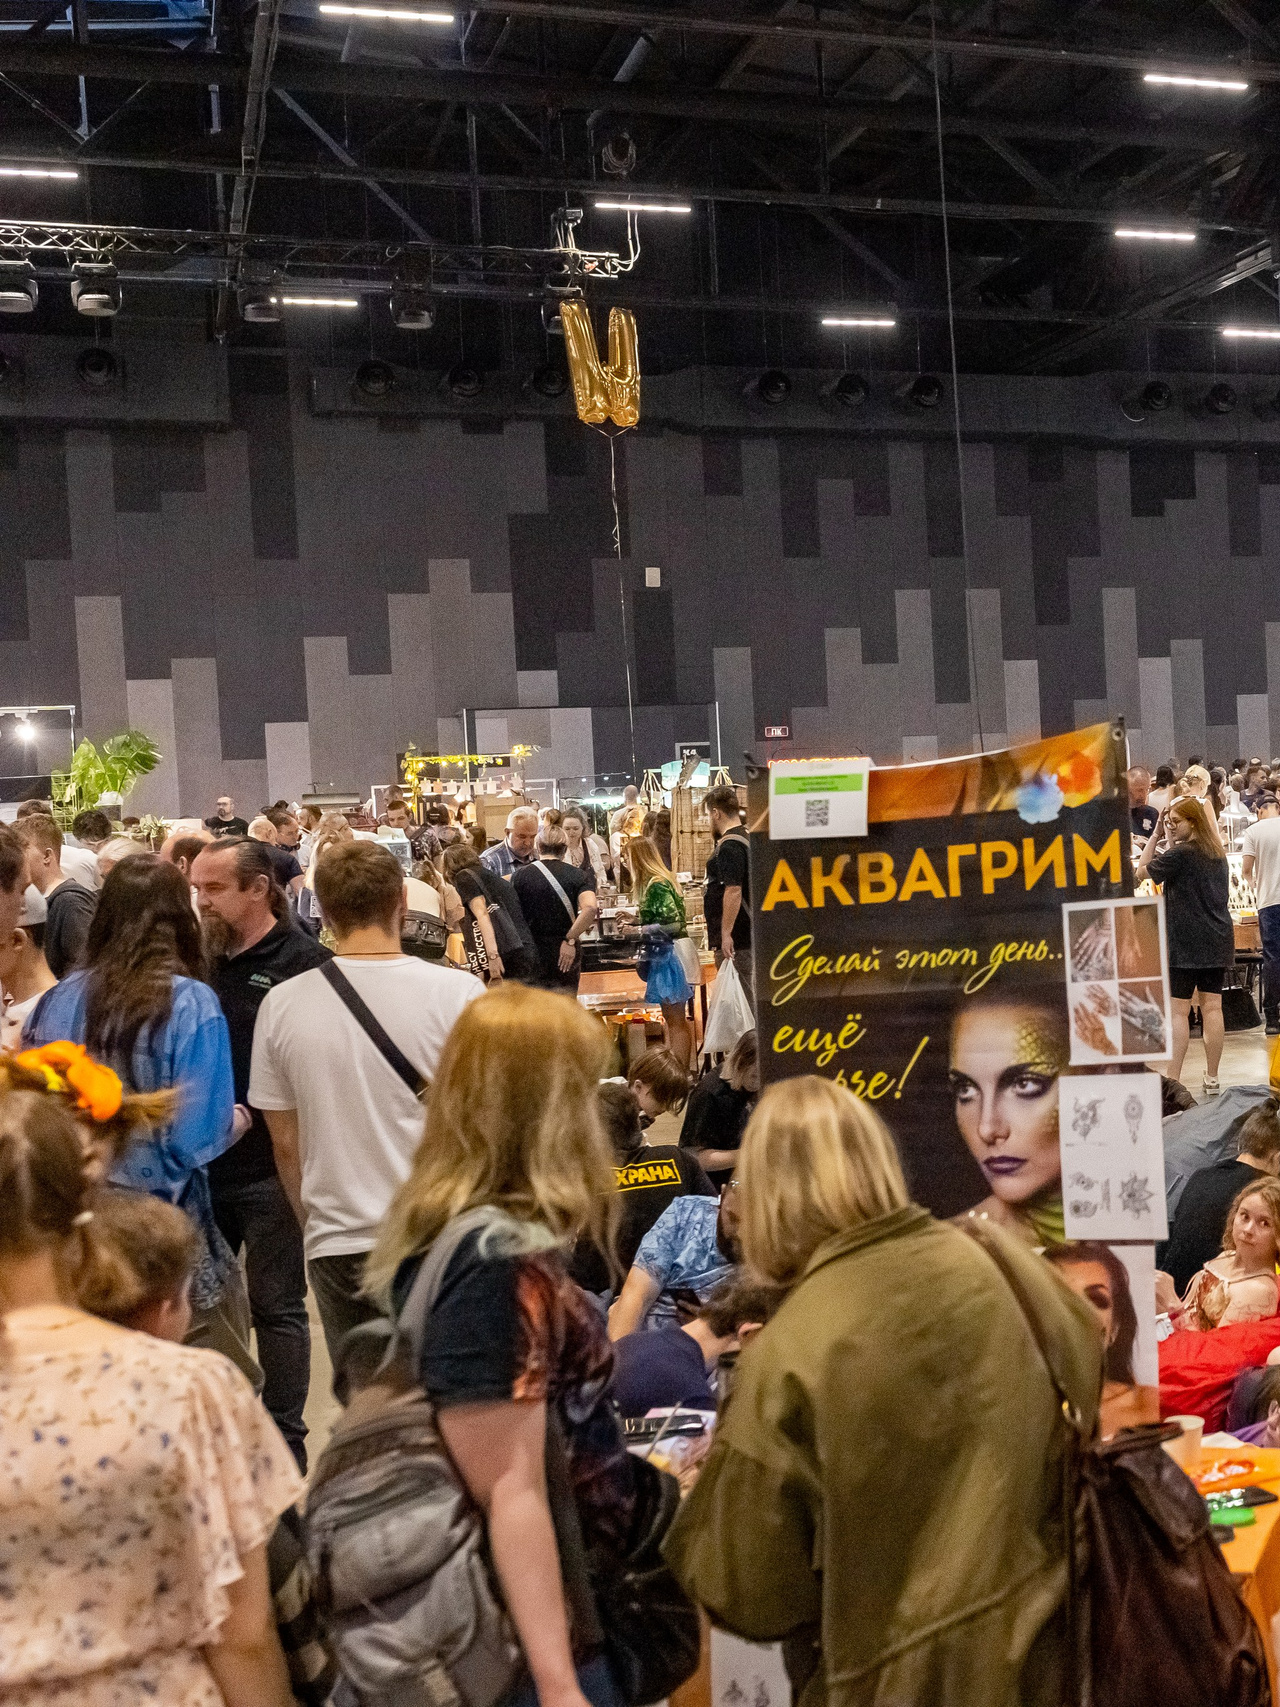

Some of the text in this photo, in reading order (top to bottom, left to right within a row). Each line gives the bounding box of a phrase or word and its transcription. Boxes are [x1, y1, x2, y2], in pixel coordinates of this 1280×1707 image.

[761, 829, 1122, 911] АКВАГРИМ
[769, 934, 882, 1007] Сделай
[895, 948, 977, 969] этот
[772, 1013, 867, 1067] ещё
[615, 1165, 676, 1187] ХРАНА
